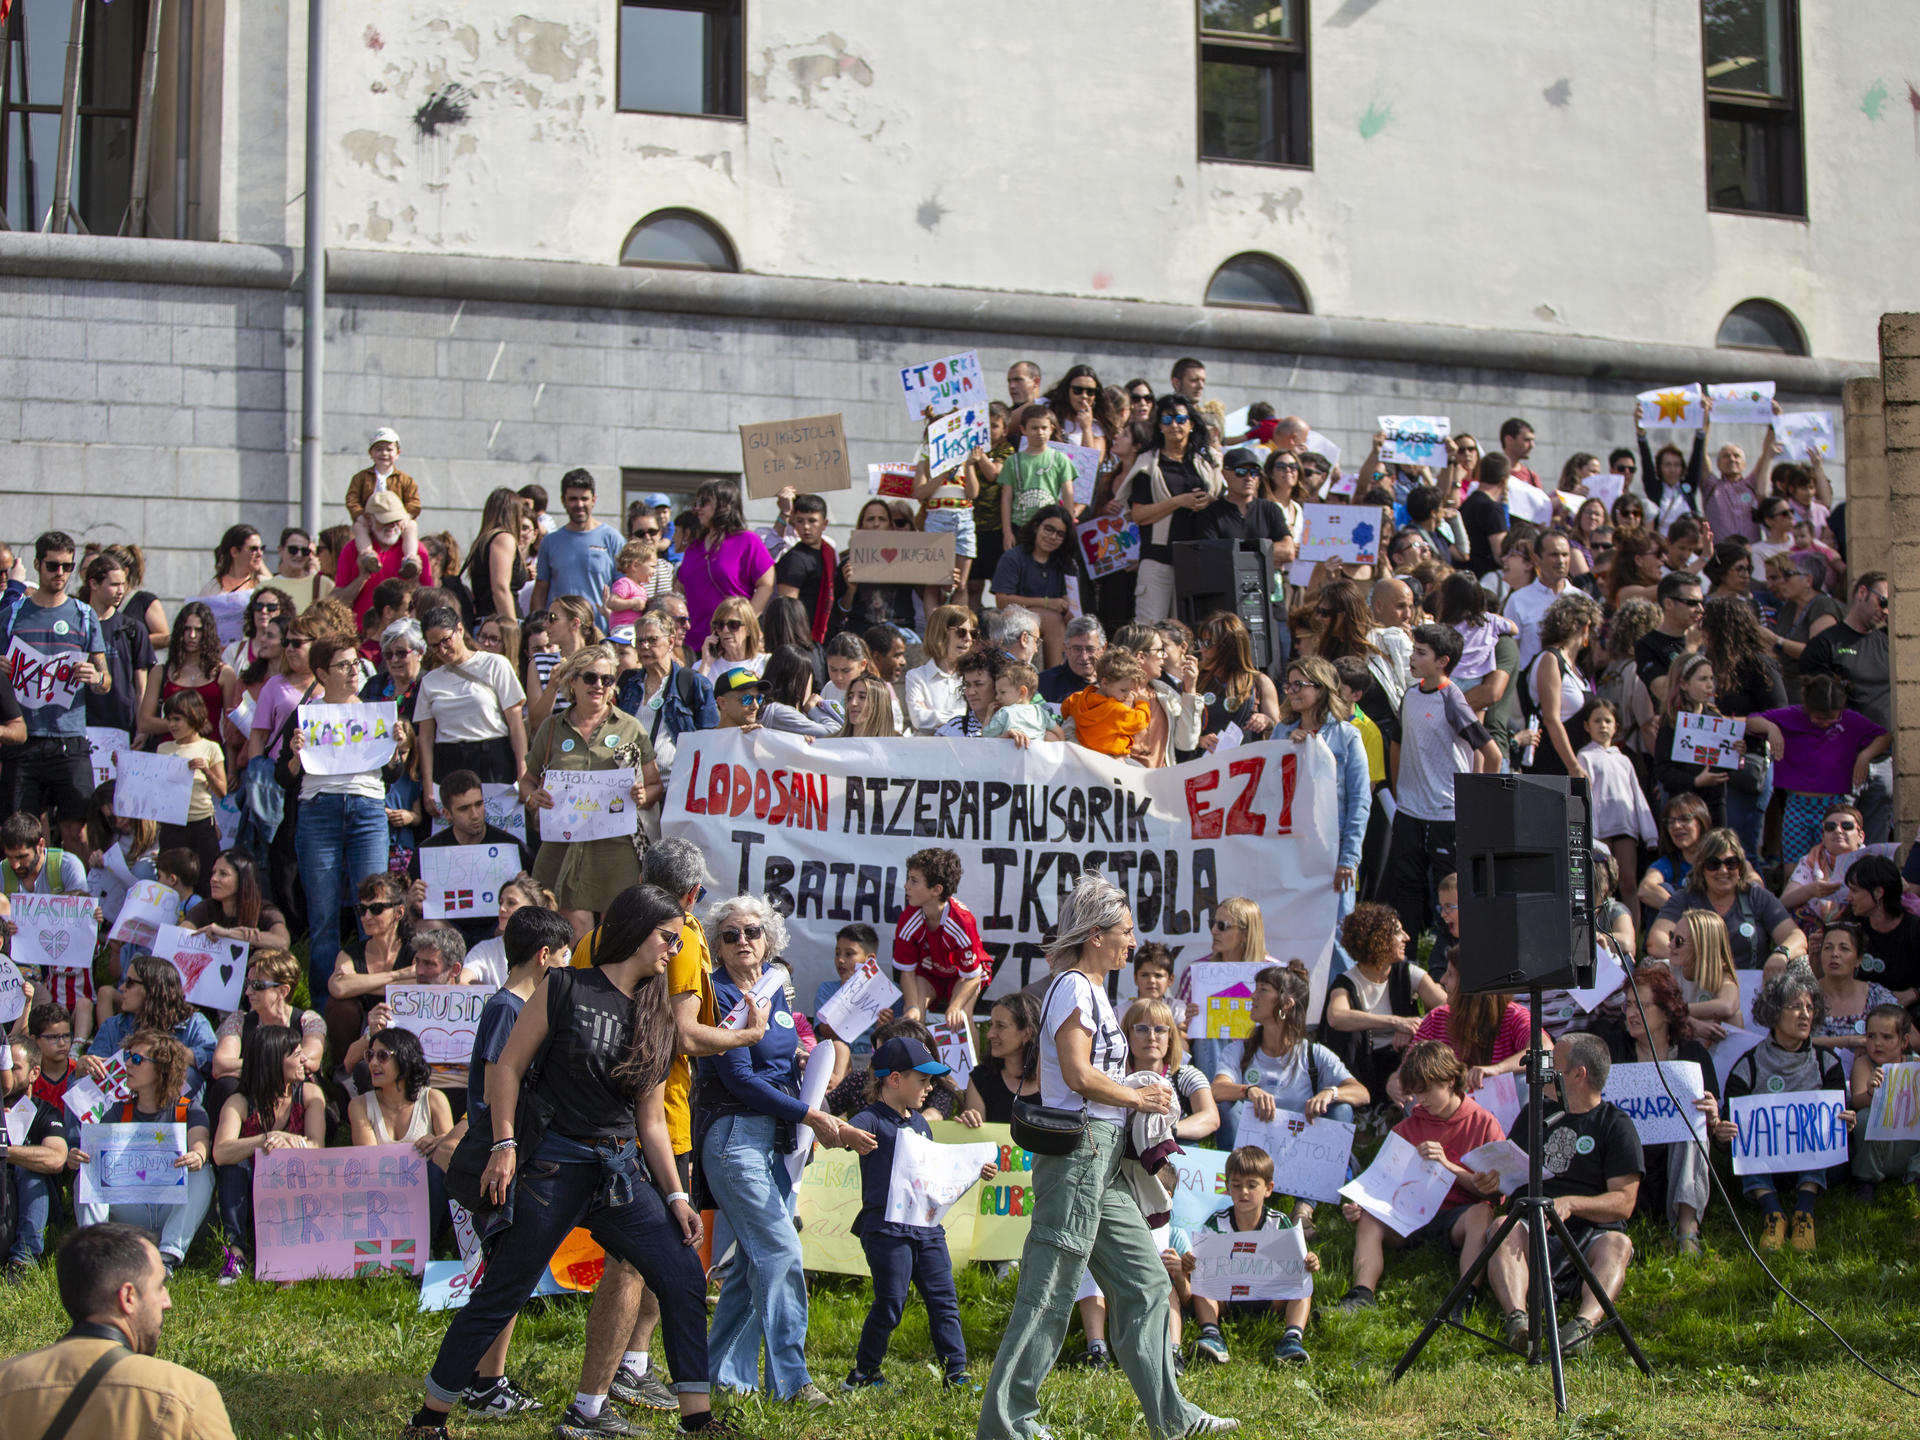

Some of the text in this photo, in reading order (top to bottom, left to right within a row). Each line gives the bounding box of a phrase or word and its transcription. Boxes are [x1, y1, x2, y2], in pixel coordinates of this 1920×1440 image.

[749, 424, 836, 449] GU IKASTOLA
[764, 460, 786, 474] ETA
[854, 547, 946, 564] NIK IKASTOLA
[685, 750, 829, 831] LODOSAN
[1185, 753, 1297, 840] EZ!
[1732, 1101, 1846, 1158] NAFARROA
[258, 1190, 412, 1247] AURRERA
